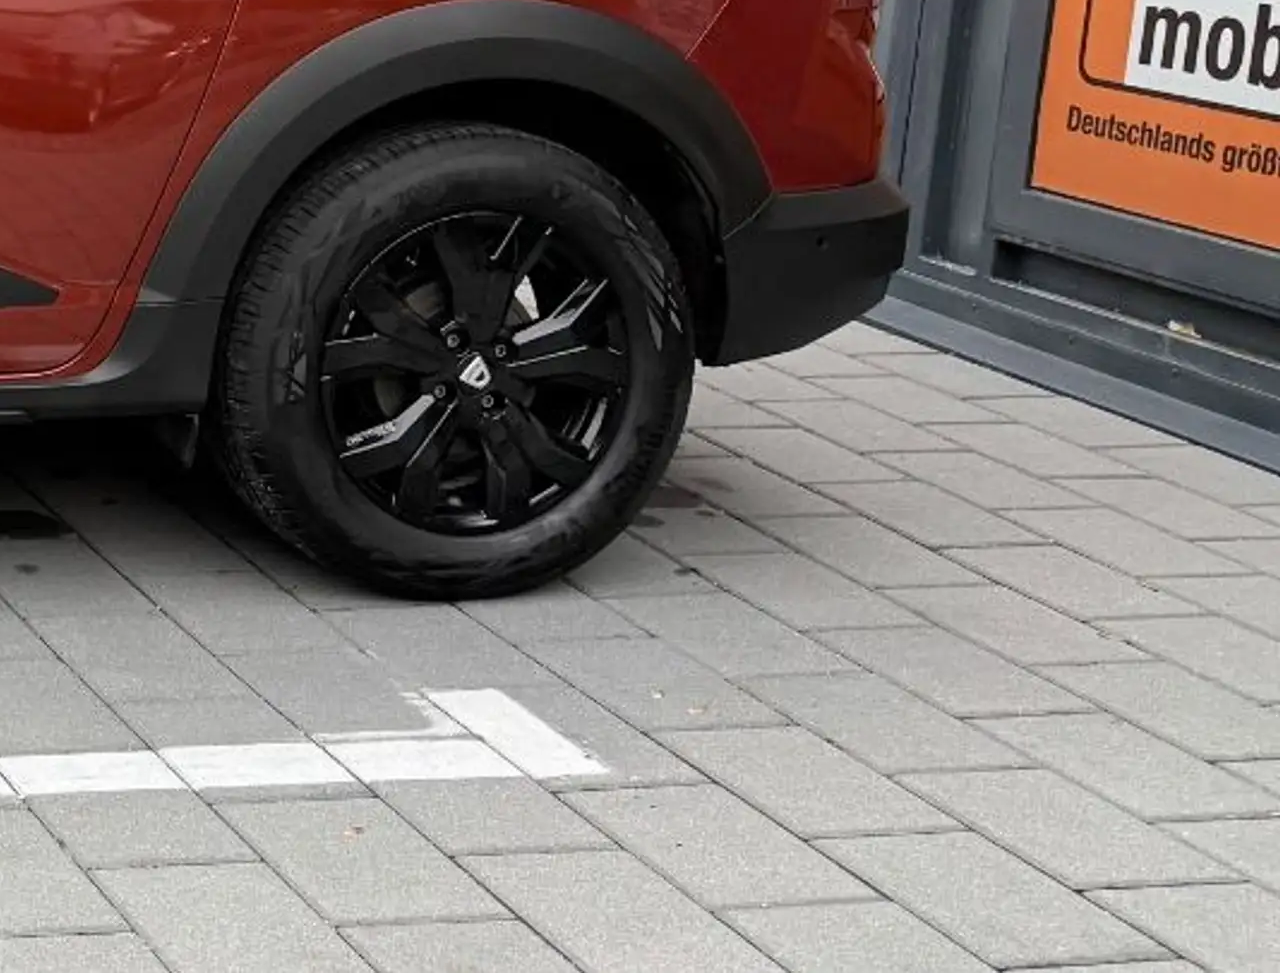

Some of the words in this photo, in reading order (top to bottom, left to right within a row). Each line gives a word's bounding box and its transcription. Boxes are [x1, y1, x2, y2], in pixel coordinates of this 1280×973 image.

[1138, 3, 1280, 90] mob
[1066, 104, 1216, 163] Deutschlands
[1221, 142, 1280, 177] größ
